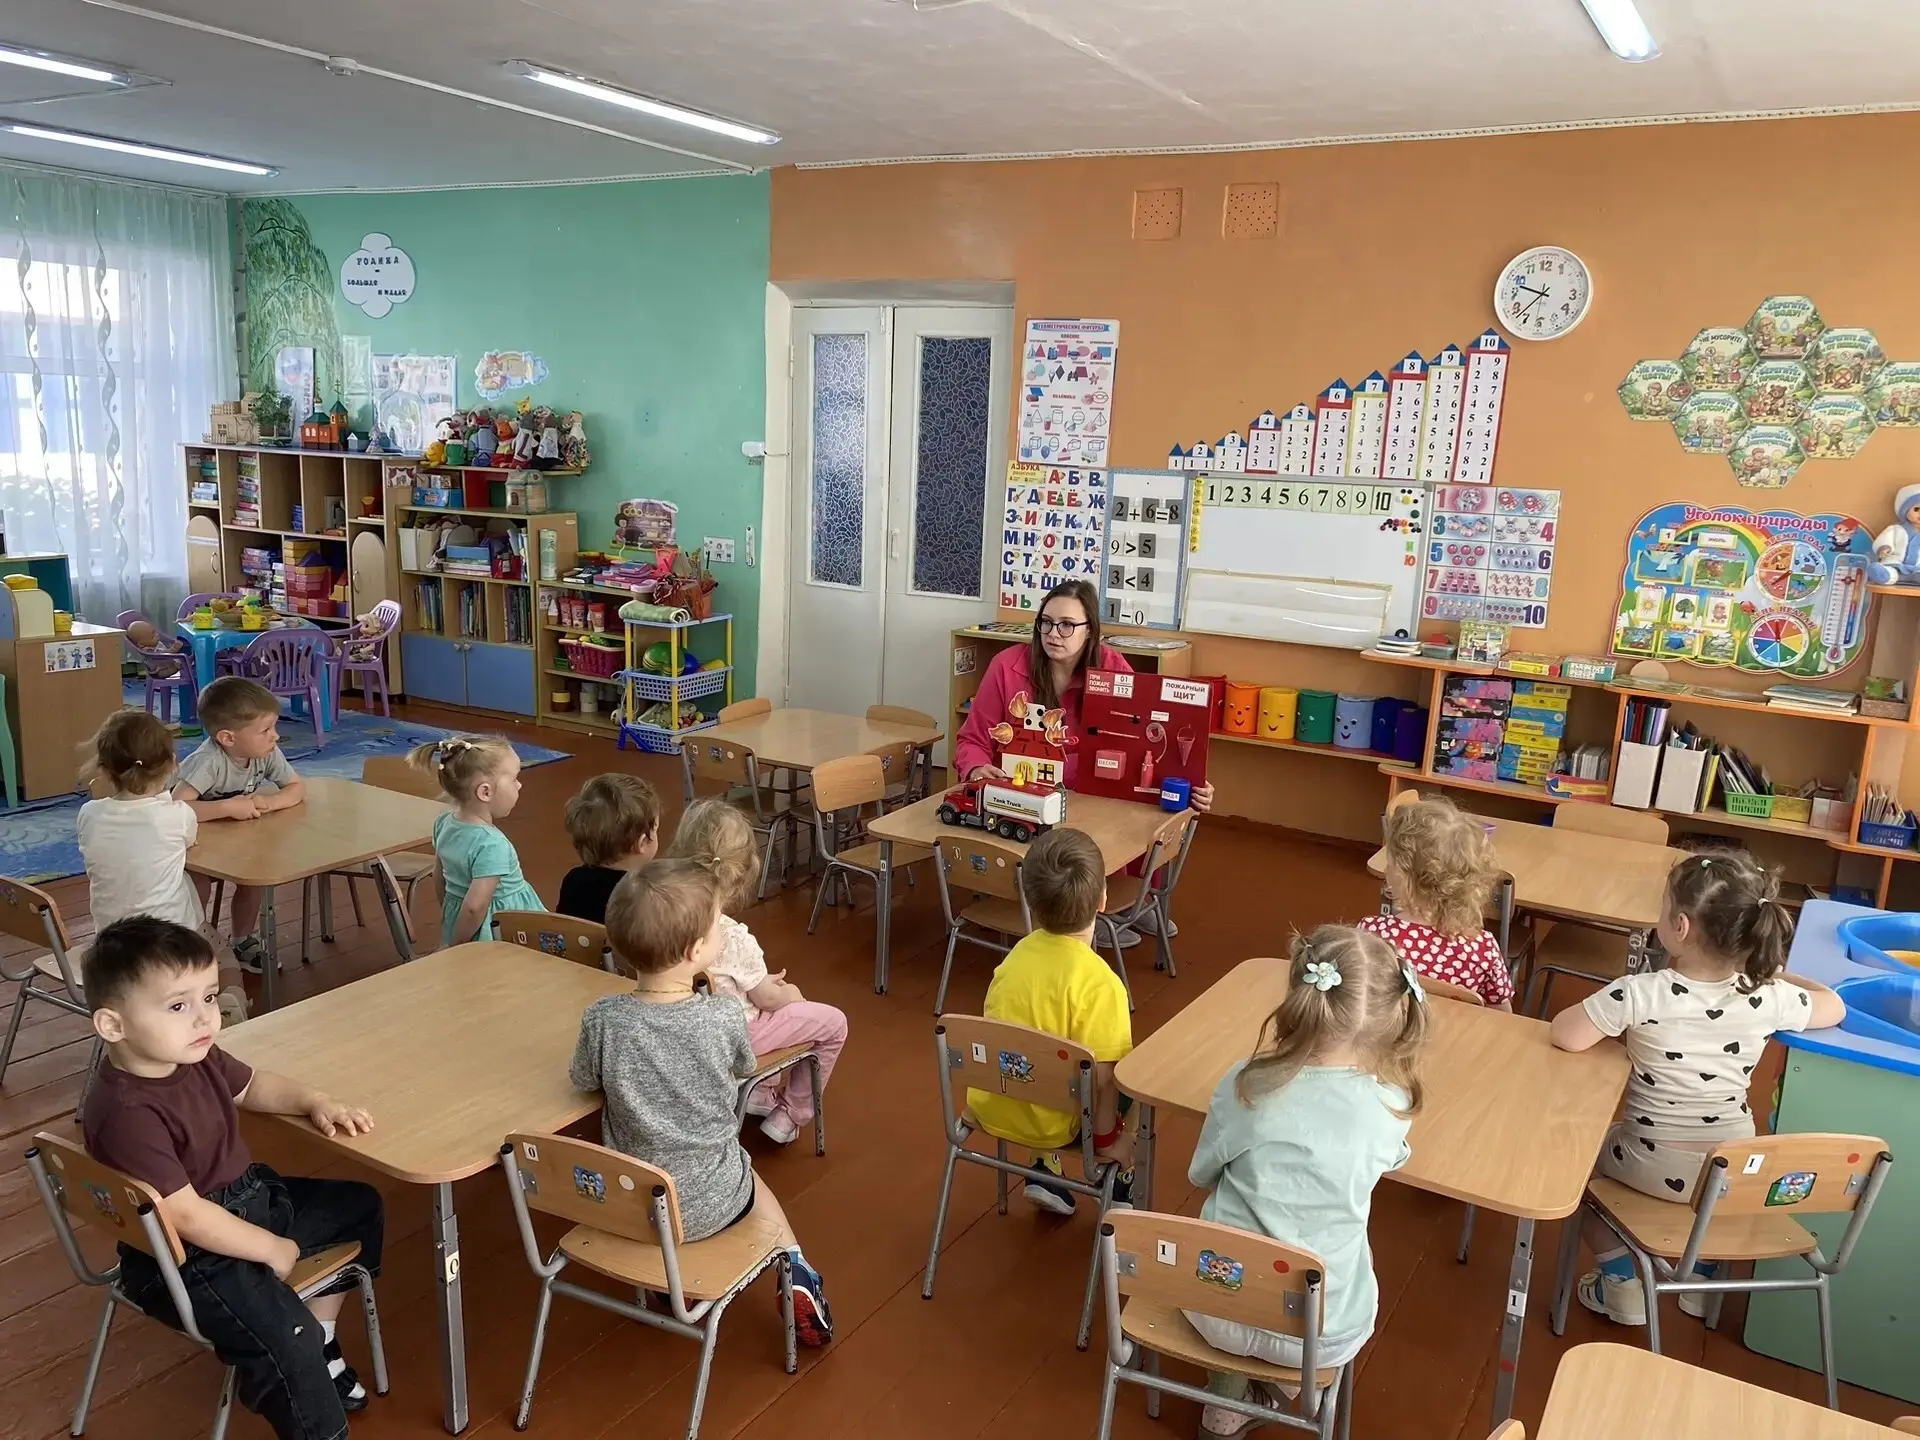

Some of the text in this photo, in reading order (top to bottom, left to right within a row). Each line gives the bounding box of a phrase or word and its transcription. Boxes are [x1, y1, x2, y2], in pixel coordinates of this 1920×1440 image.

[1525, 264, 1535, 274] 11
[1540, 260, 1552, 272] 12
[1558, 264, 1564, 275] 1
[1513, 275, 1526, 286] 10
[1568, 288, 1577, 300] 3
[1560, 303, 1570, 316] 4
[1522, 313, 1530, 324] 7
[1484, 337, 1496, 348] 10
[1711, 334, 1742, 343] МУСОРИТЕ!
[1447, 352, 1454, 364] 9
[1477, 356, 1501, 367] 1 9
[1408, 361, 1416, 372] 8
[1474, 369, 1500, 381] 2 8
[1371, 382, 1378, 392] 7
[1472, 384, 1498, 395] 3 7
[1334, 390, 1341, 401] 6
[1470, 399, 1495, 410] 4 6
[1296, 407, 1304, 418] 5
[1263, 416, 1270, 426] 4
[1468, 413, 1494, 424] 5 5
[1466, 427, 1491, 438] 6 4
[1229, 435, 1236, 445] 3
[1196, 446, 1203, 456] 2
[1465, 441, 1489, 452] 7 3
[1462, 455, 1488, 466] 8 2
[1048, 469, 1060, 484] А
[1068, 470, 1079, 485] Б
[1089, 472, 1100, 486] В
[1460, 469, 1484, 480] 9 1
[1008, 488, 1104, 509] Г Д Е Ё Ж
[1207, 484, 1392, 511] 1 2 3 4 5 6 7 8 9 10
[1437, 488, 1558, 514] 1 2
[1115, 502, 1179, 520] 2 + 6 = 8
[1006, 509, 1017, 523] З
[1024, 510, 1037, 525] И
[1045, 509, 1057, 527] Й
[1065, 514, 1077, 529] К
[1686, 507, 1826, 530] Уголок природы
[1433, 515, 1554, 542] 3 4
[1004, 530, 1096, 551] М Н О П Р
[1111, 540, 1120, 555] 9
[1143, 539, 1152, 554] 5
[1004, 551, 1096, 573] С Т У Ф Х
[1430, 543, 1552, 570] 5 6
[1002, 571, 1014, 587] Ц
[1022, 574, 1032, 588] Ч
[1041, 576, 1057, 590] Ш
[1111, 570, 1120, 585] 3
[1140, 573, 1150, 587] 4
[1428, 569, 1548, 598] 7 8
[1002, 592, 1031, 608] Ы Ь
[1110, 603, 1144, 625] 1 0
[1425, 596, 1545, 624] 9 10
[1166, 683, 1206, 692] ПОЖАРНЫЙ
[1173, 692, 1195, 700] ЩИТ
[1162, 791, 1178, 799] ВОДА
[975, 1046, 979, 1056] 1
[528, 1147, 535, 1158] 0
[1749, 1158, 1755, 1167] 1
[1161, 1245, 1166, 1255] 1
[1510, 1295, 1517, 1307] 1
